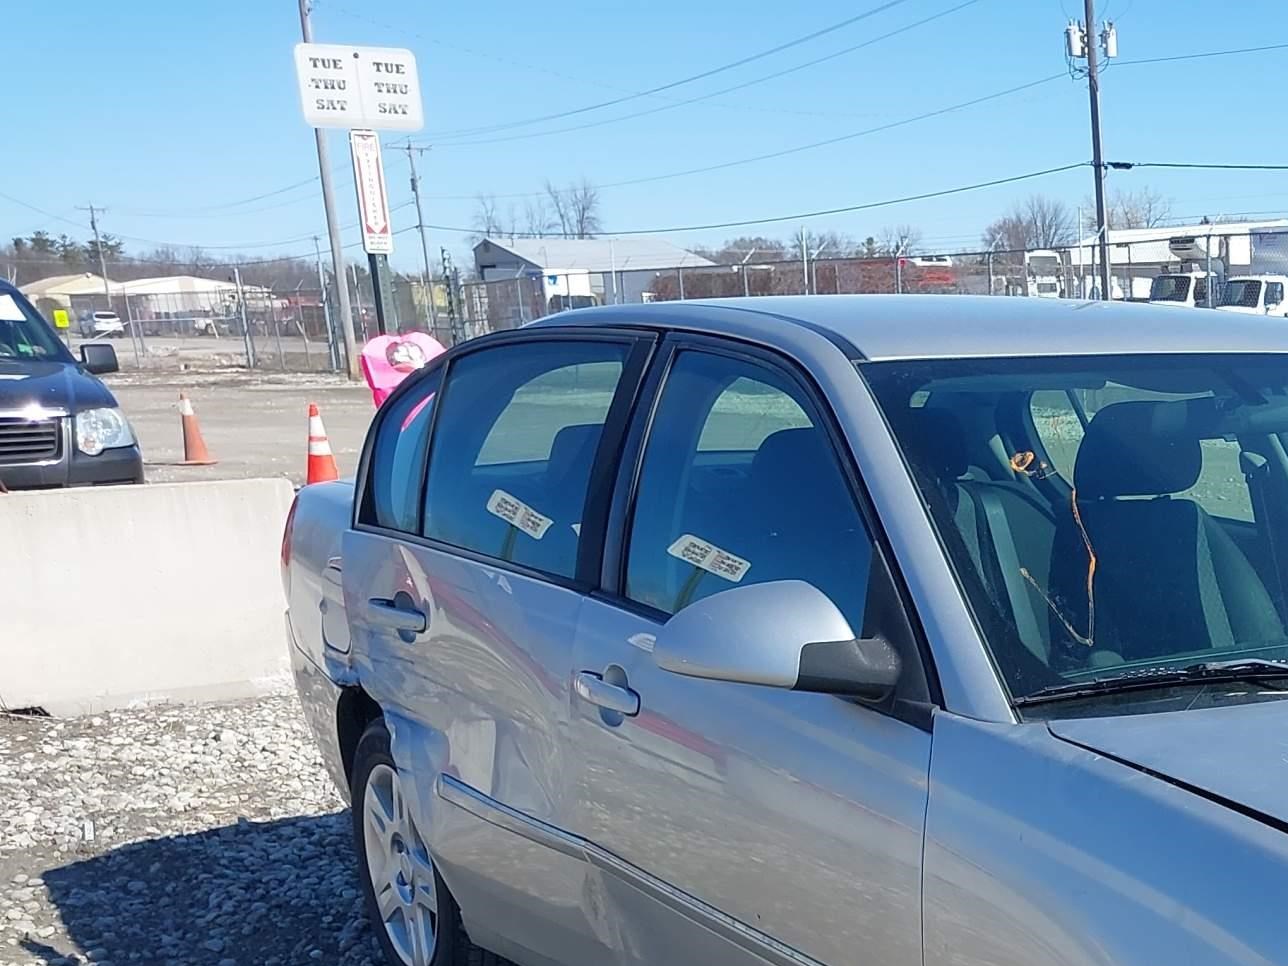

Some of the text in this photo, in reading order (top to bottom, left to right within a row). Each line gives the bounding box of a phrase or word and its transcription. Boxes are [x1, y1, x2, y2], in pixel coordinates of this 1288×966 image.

[309, 57, 343, 70] TUE
[372, 61, 406, 75] TUE
[310, 78, 347, 91] THU
[374, 82, 409, 95] THU
[315, 99, 348, 111] SAT
[378, 102, 409, 115] SAT
